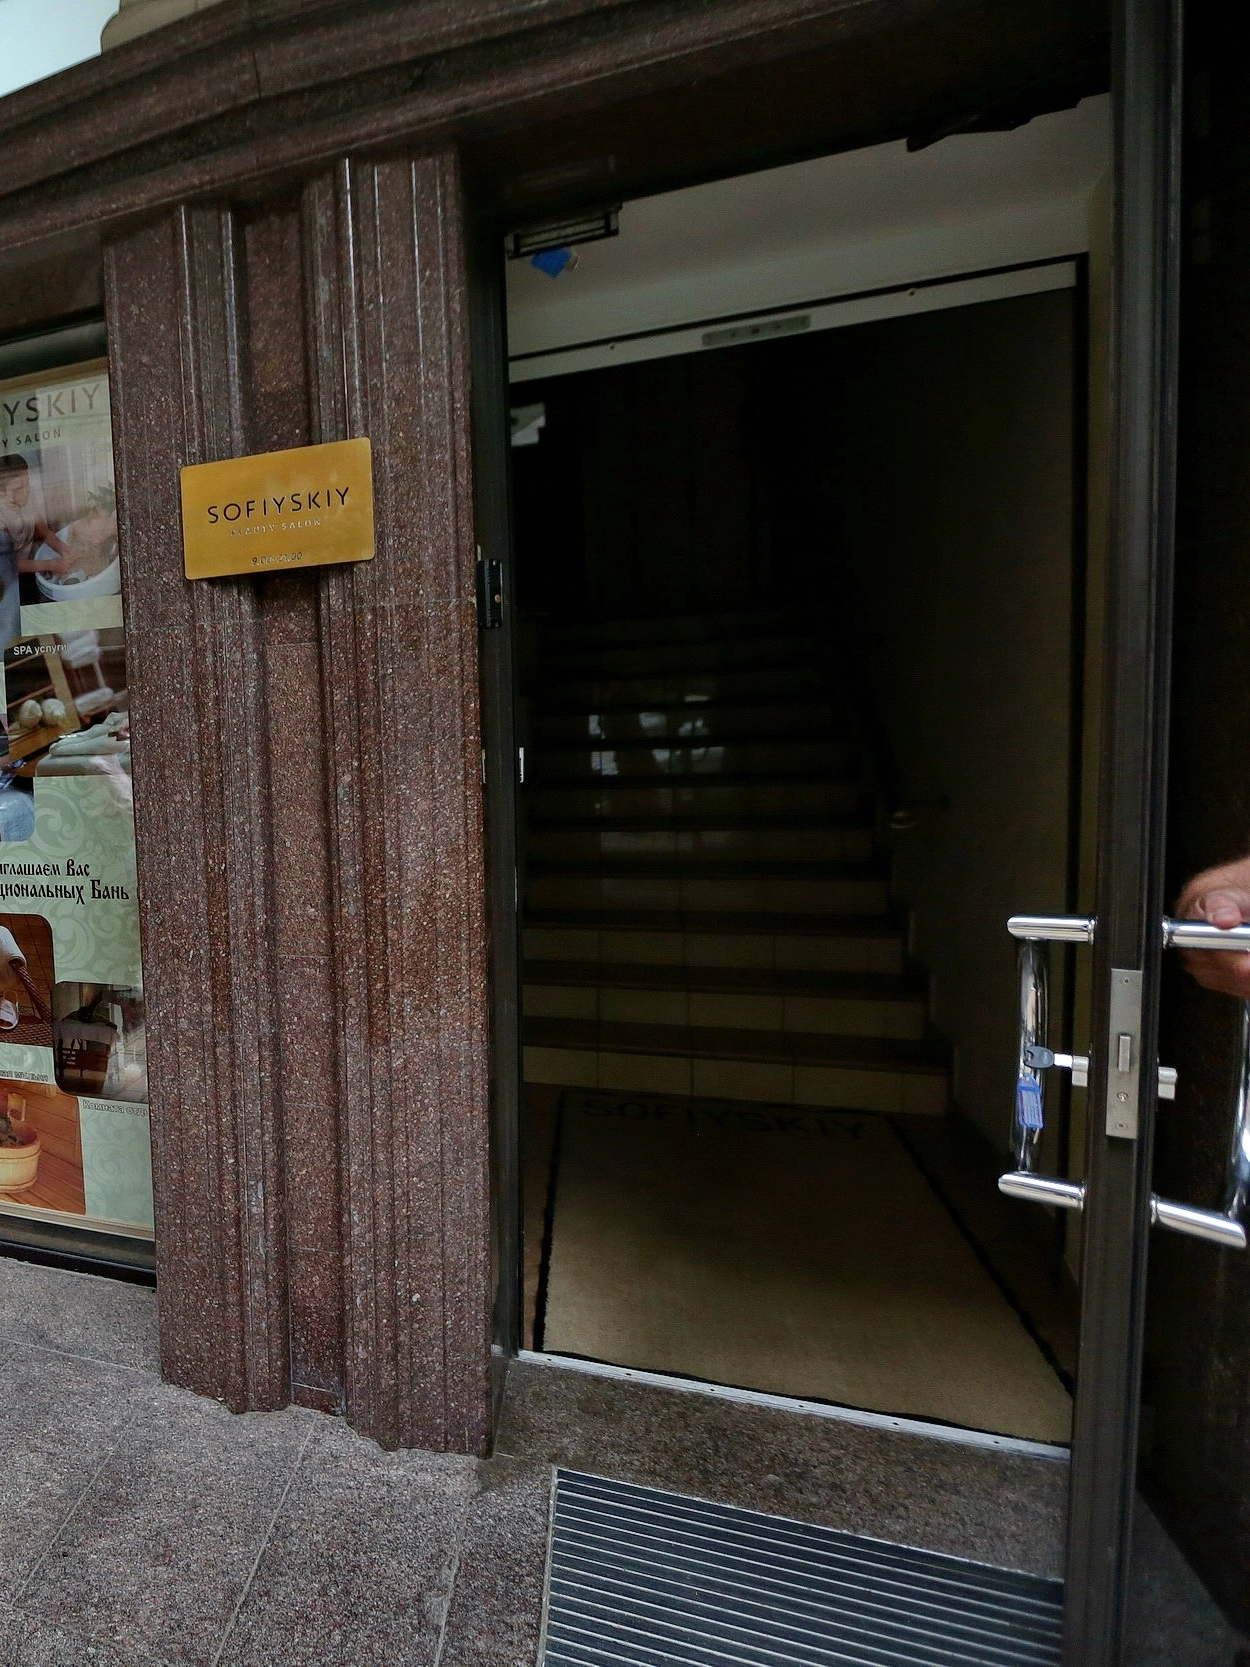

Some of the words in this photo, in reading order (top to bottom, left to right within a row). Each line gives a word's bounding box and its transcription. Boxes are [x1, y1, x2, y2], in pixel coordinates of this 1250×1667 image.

[16, 428, 61, 446] SALON
[207, 486, 350, 524] SOFIYSKIY
[13, 645, 33, 656] SPA
[34, 644, 67, 656] услуги
[66, 858, 90, 876] Вас
[90, 879, 130, 900] Бань
[82, 1099, 125, 1114] Комната
